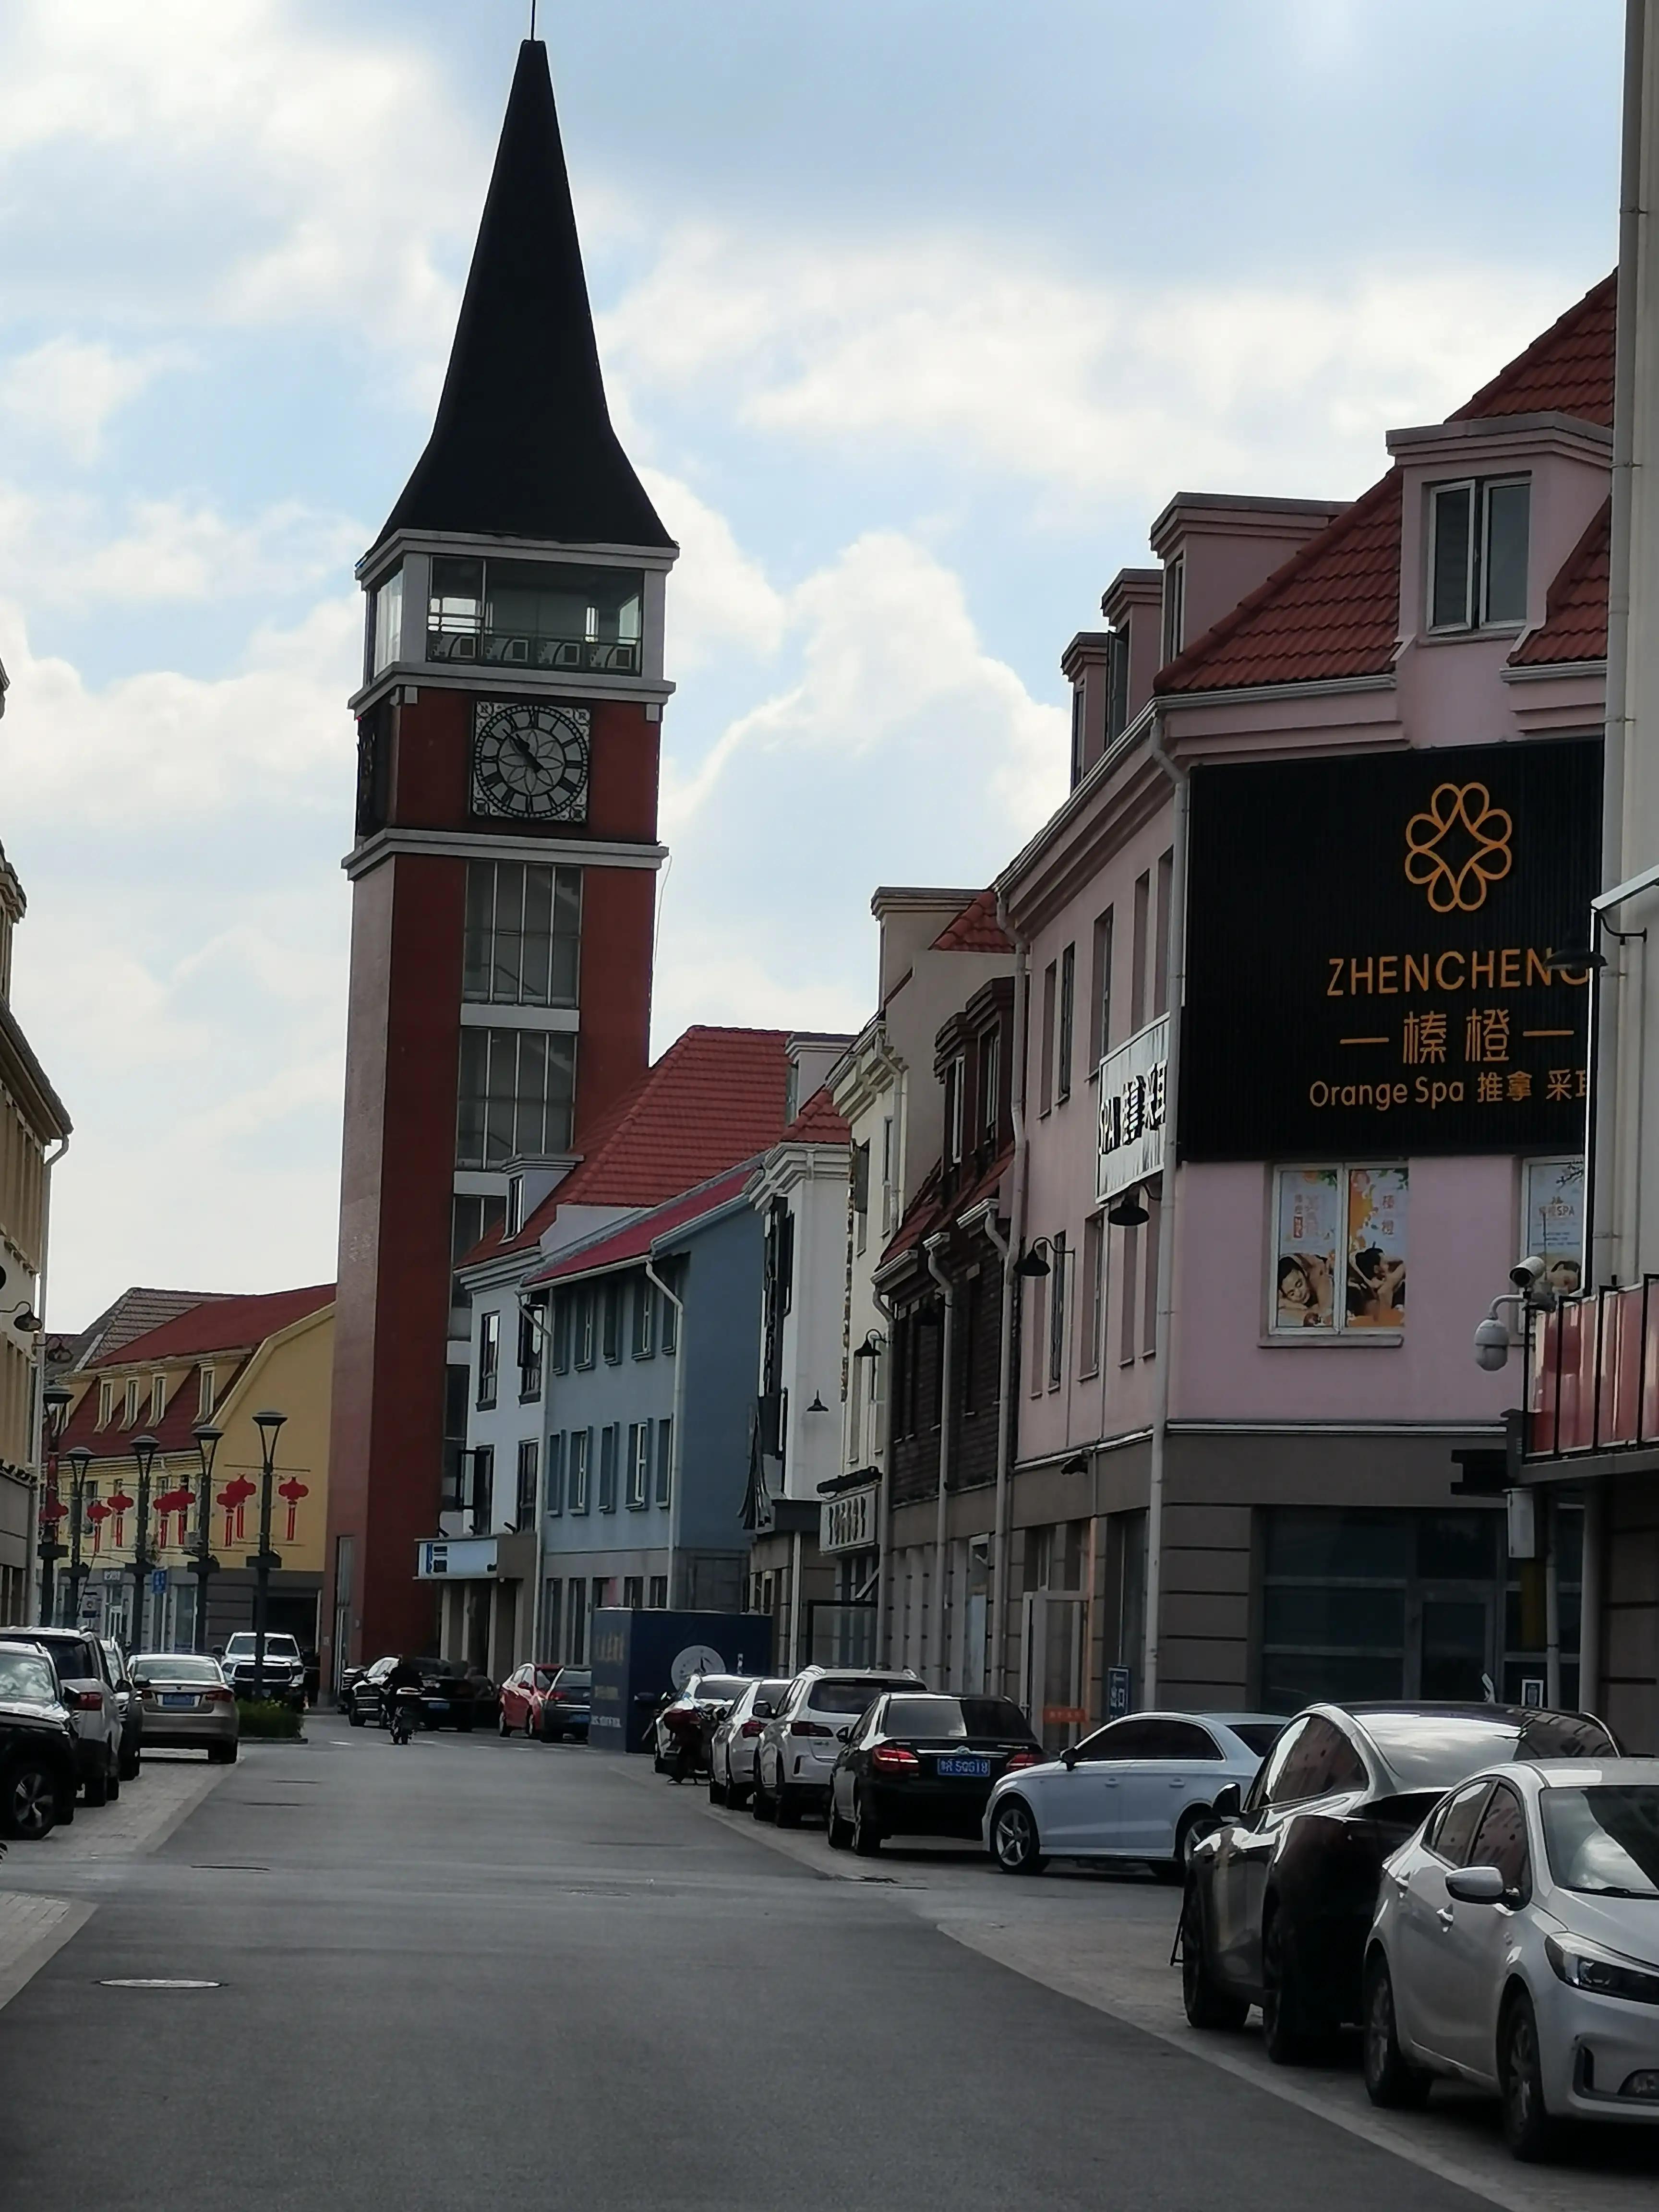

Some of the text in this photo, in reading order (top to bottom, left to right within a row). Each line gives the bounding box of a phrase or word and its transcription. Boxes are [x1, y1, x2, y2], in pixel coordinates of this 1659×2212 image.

[1403, 1008, 1509, 1064] 榛橙
[1310, 1081, 1407, 1111] Orange
[1415, 1076, 1464, 1109] Spa
[1477, 1070, 1532, 1102] 推拿
